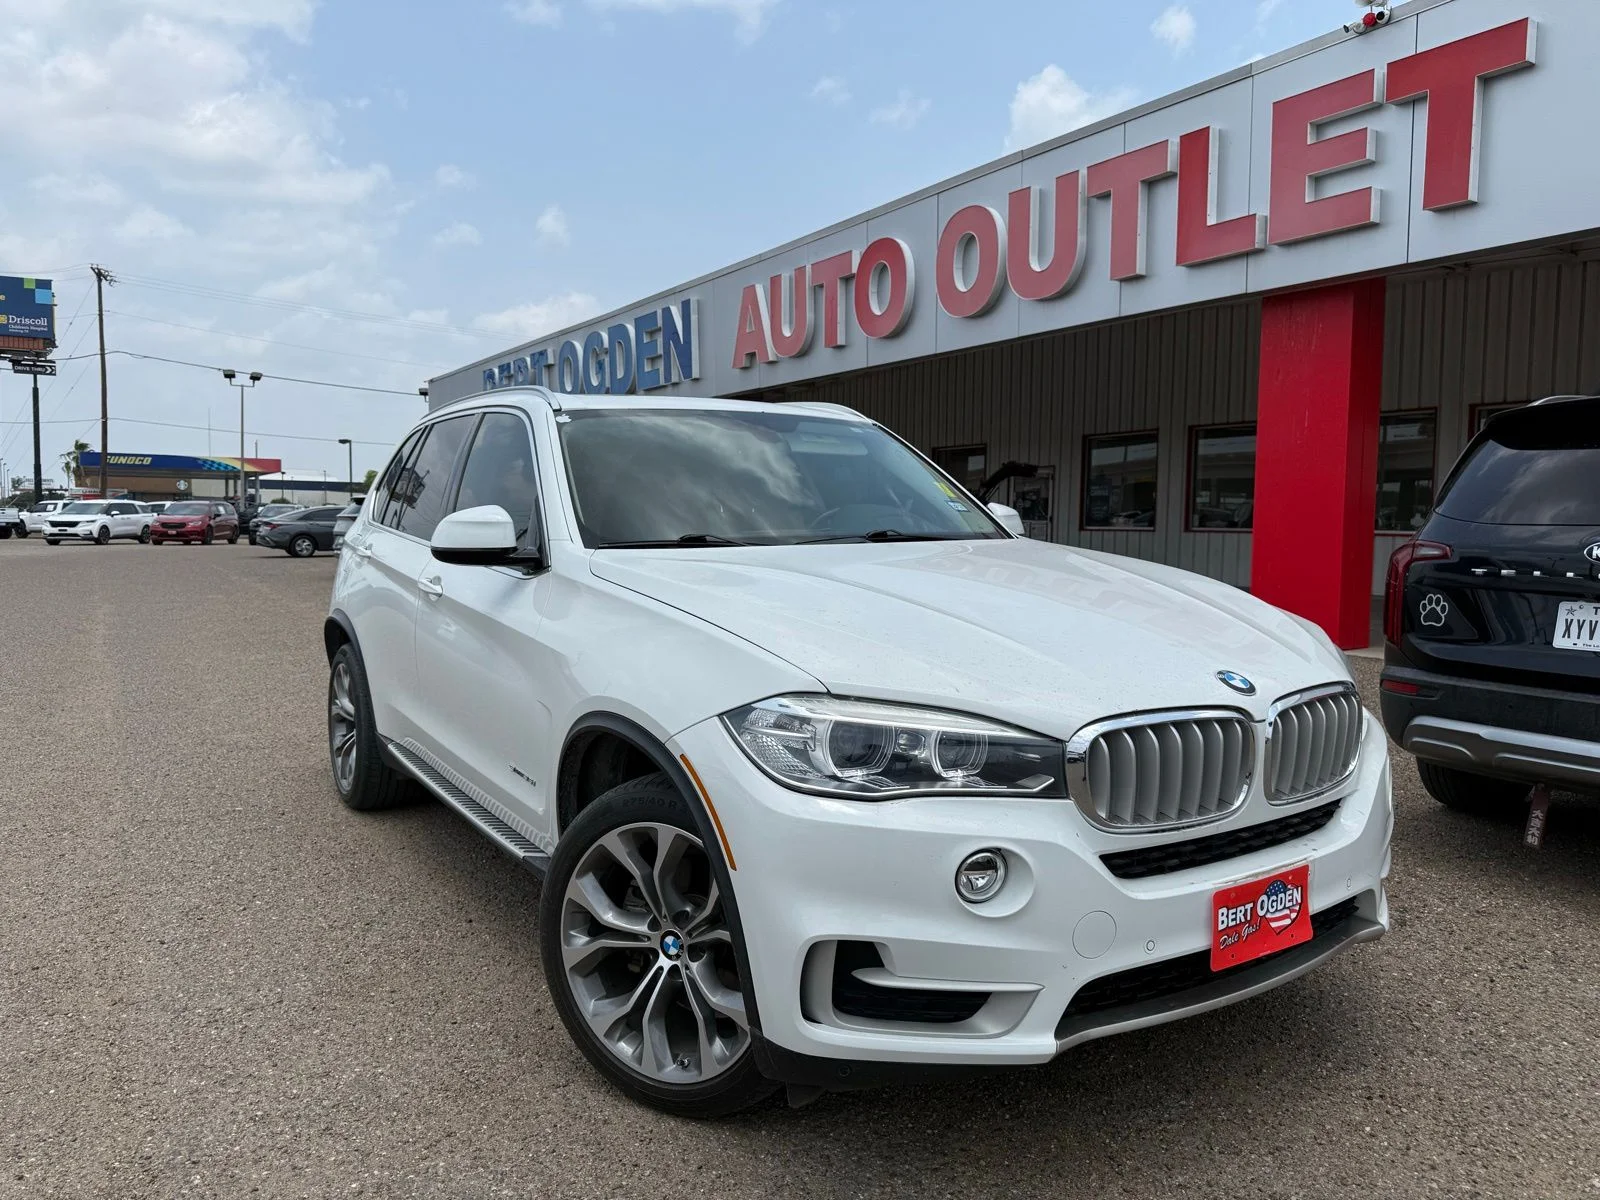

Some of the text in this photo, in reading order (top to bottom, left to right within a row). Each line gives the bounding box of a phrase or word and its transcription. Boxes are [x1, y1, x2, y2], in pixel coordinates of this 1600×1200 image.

[558, 298, 699, 395] OGDEN
[731, 236, 915, 369] AUTO
[936, 17, 1538, 318] OUTLET
[8, 314, 48, 326] Driscoll
[1217, 886, 1302, 932] BERT OGDEN
[1219, 916, 1261, 950] Dale Gas!
